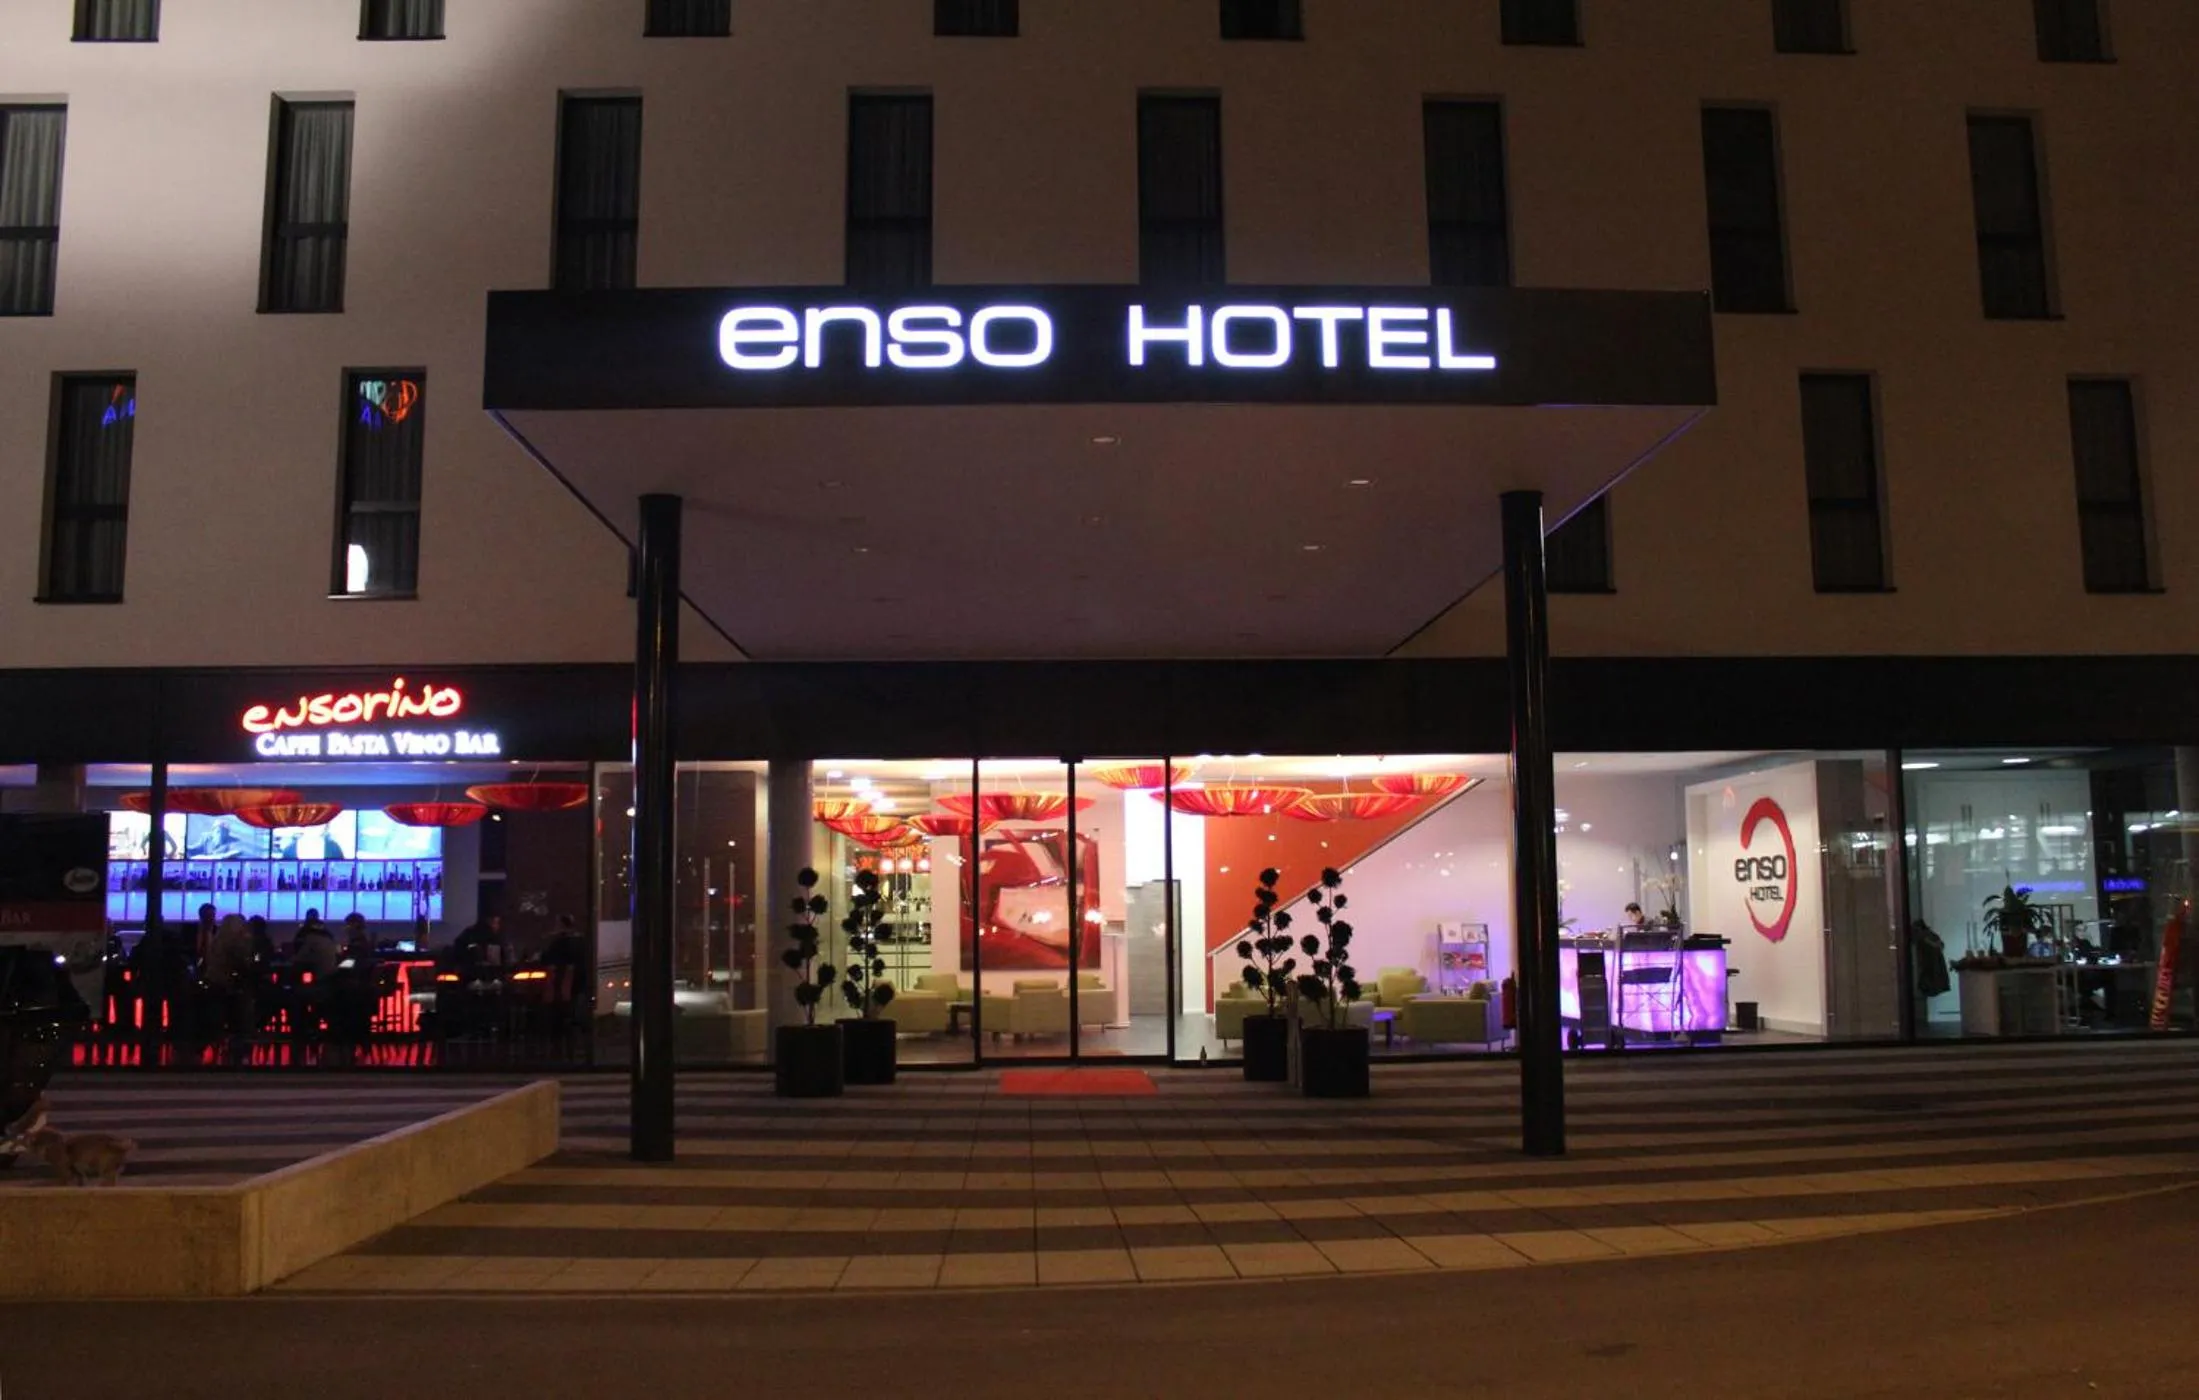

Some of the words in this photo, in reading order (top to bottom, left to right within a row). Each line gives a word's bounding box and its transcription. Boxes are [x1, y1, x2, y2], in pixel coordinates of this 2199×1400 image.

[718, 305, 1054, 371] enso
[1128, 304, 1498, 370] HOTEL
[327, 731, 391, 756] PASTA
[392, 731, 451, 756] VINO
[454, 730, 501, 755] BAR
[1734, 855, 1787, 882] enso
[1750, 885, 1785, 902] HOTEL
